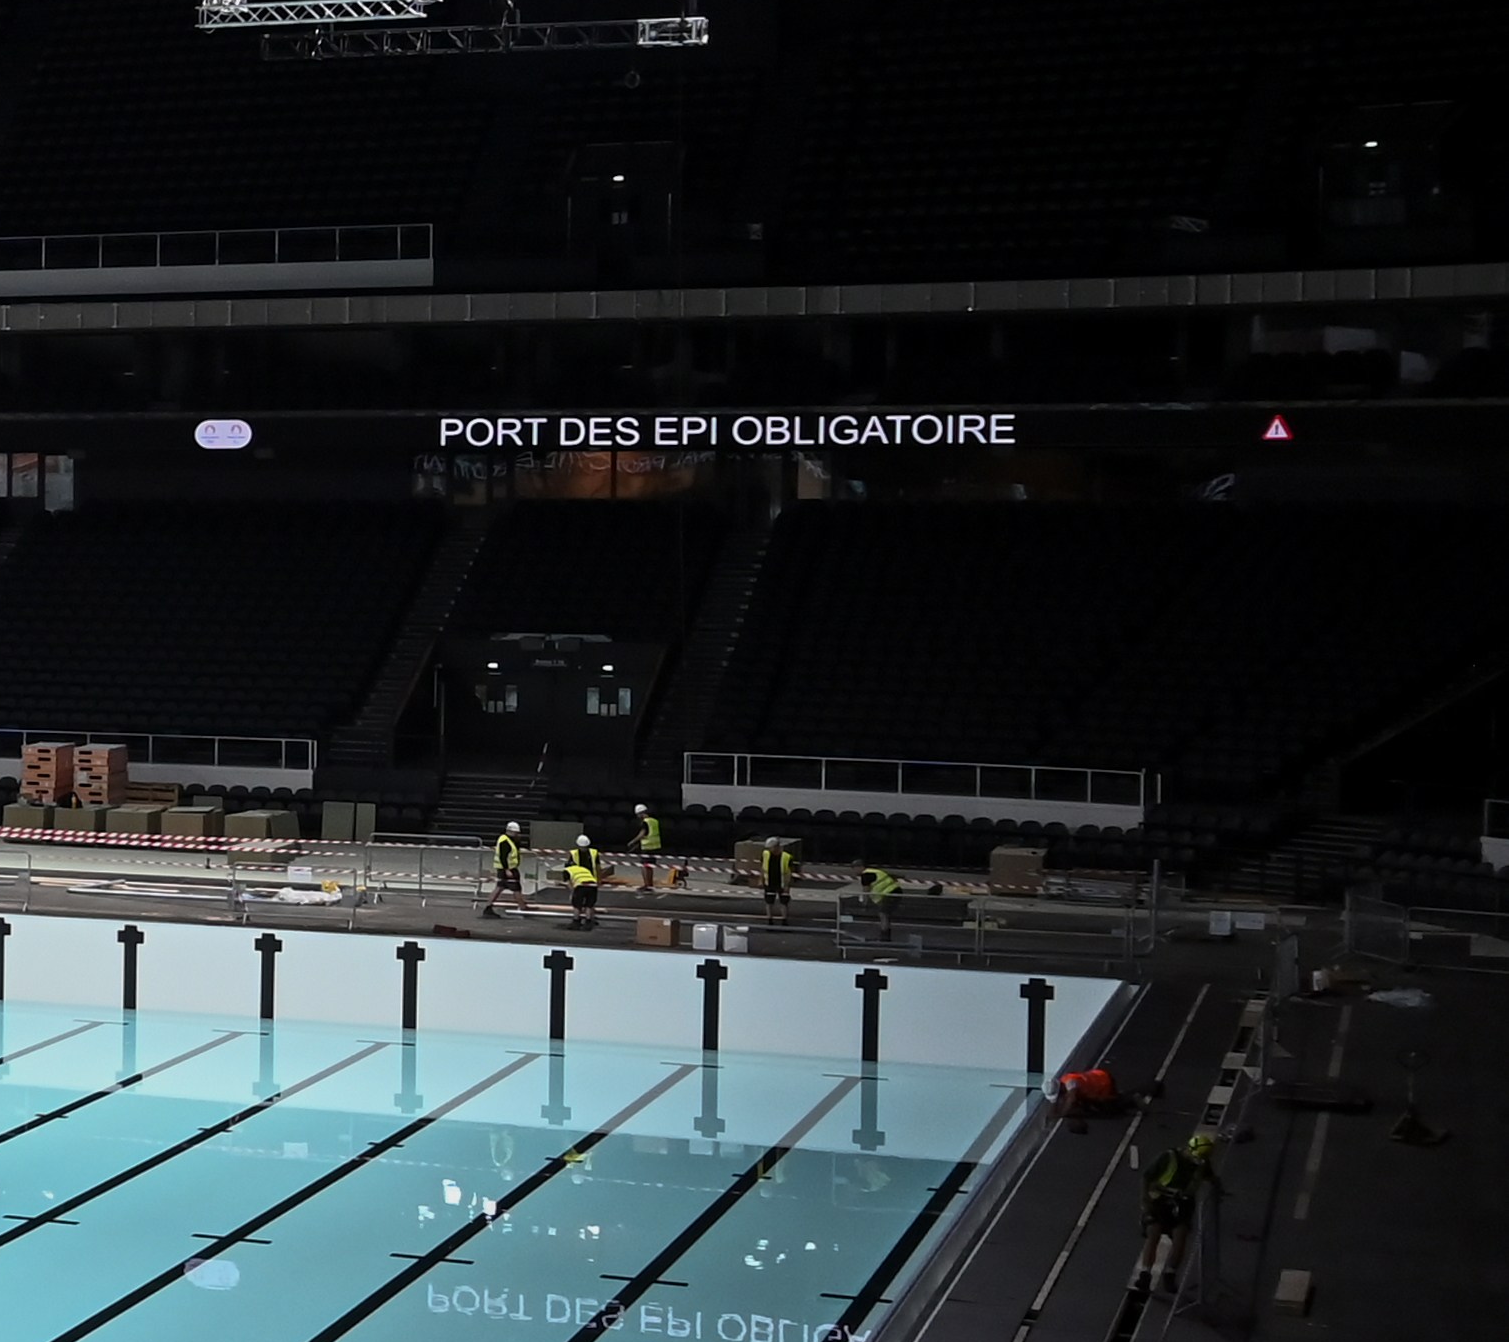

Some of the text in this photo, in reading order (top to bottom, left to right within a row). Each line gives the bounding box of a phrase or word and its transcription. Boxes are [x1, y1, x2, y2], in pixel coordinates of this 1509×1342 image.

[440, 413, 1016, 447] PORT DES EPI OBLIGATOIRE
